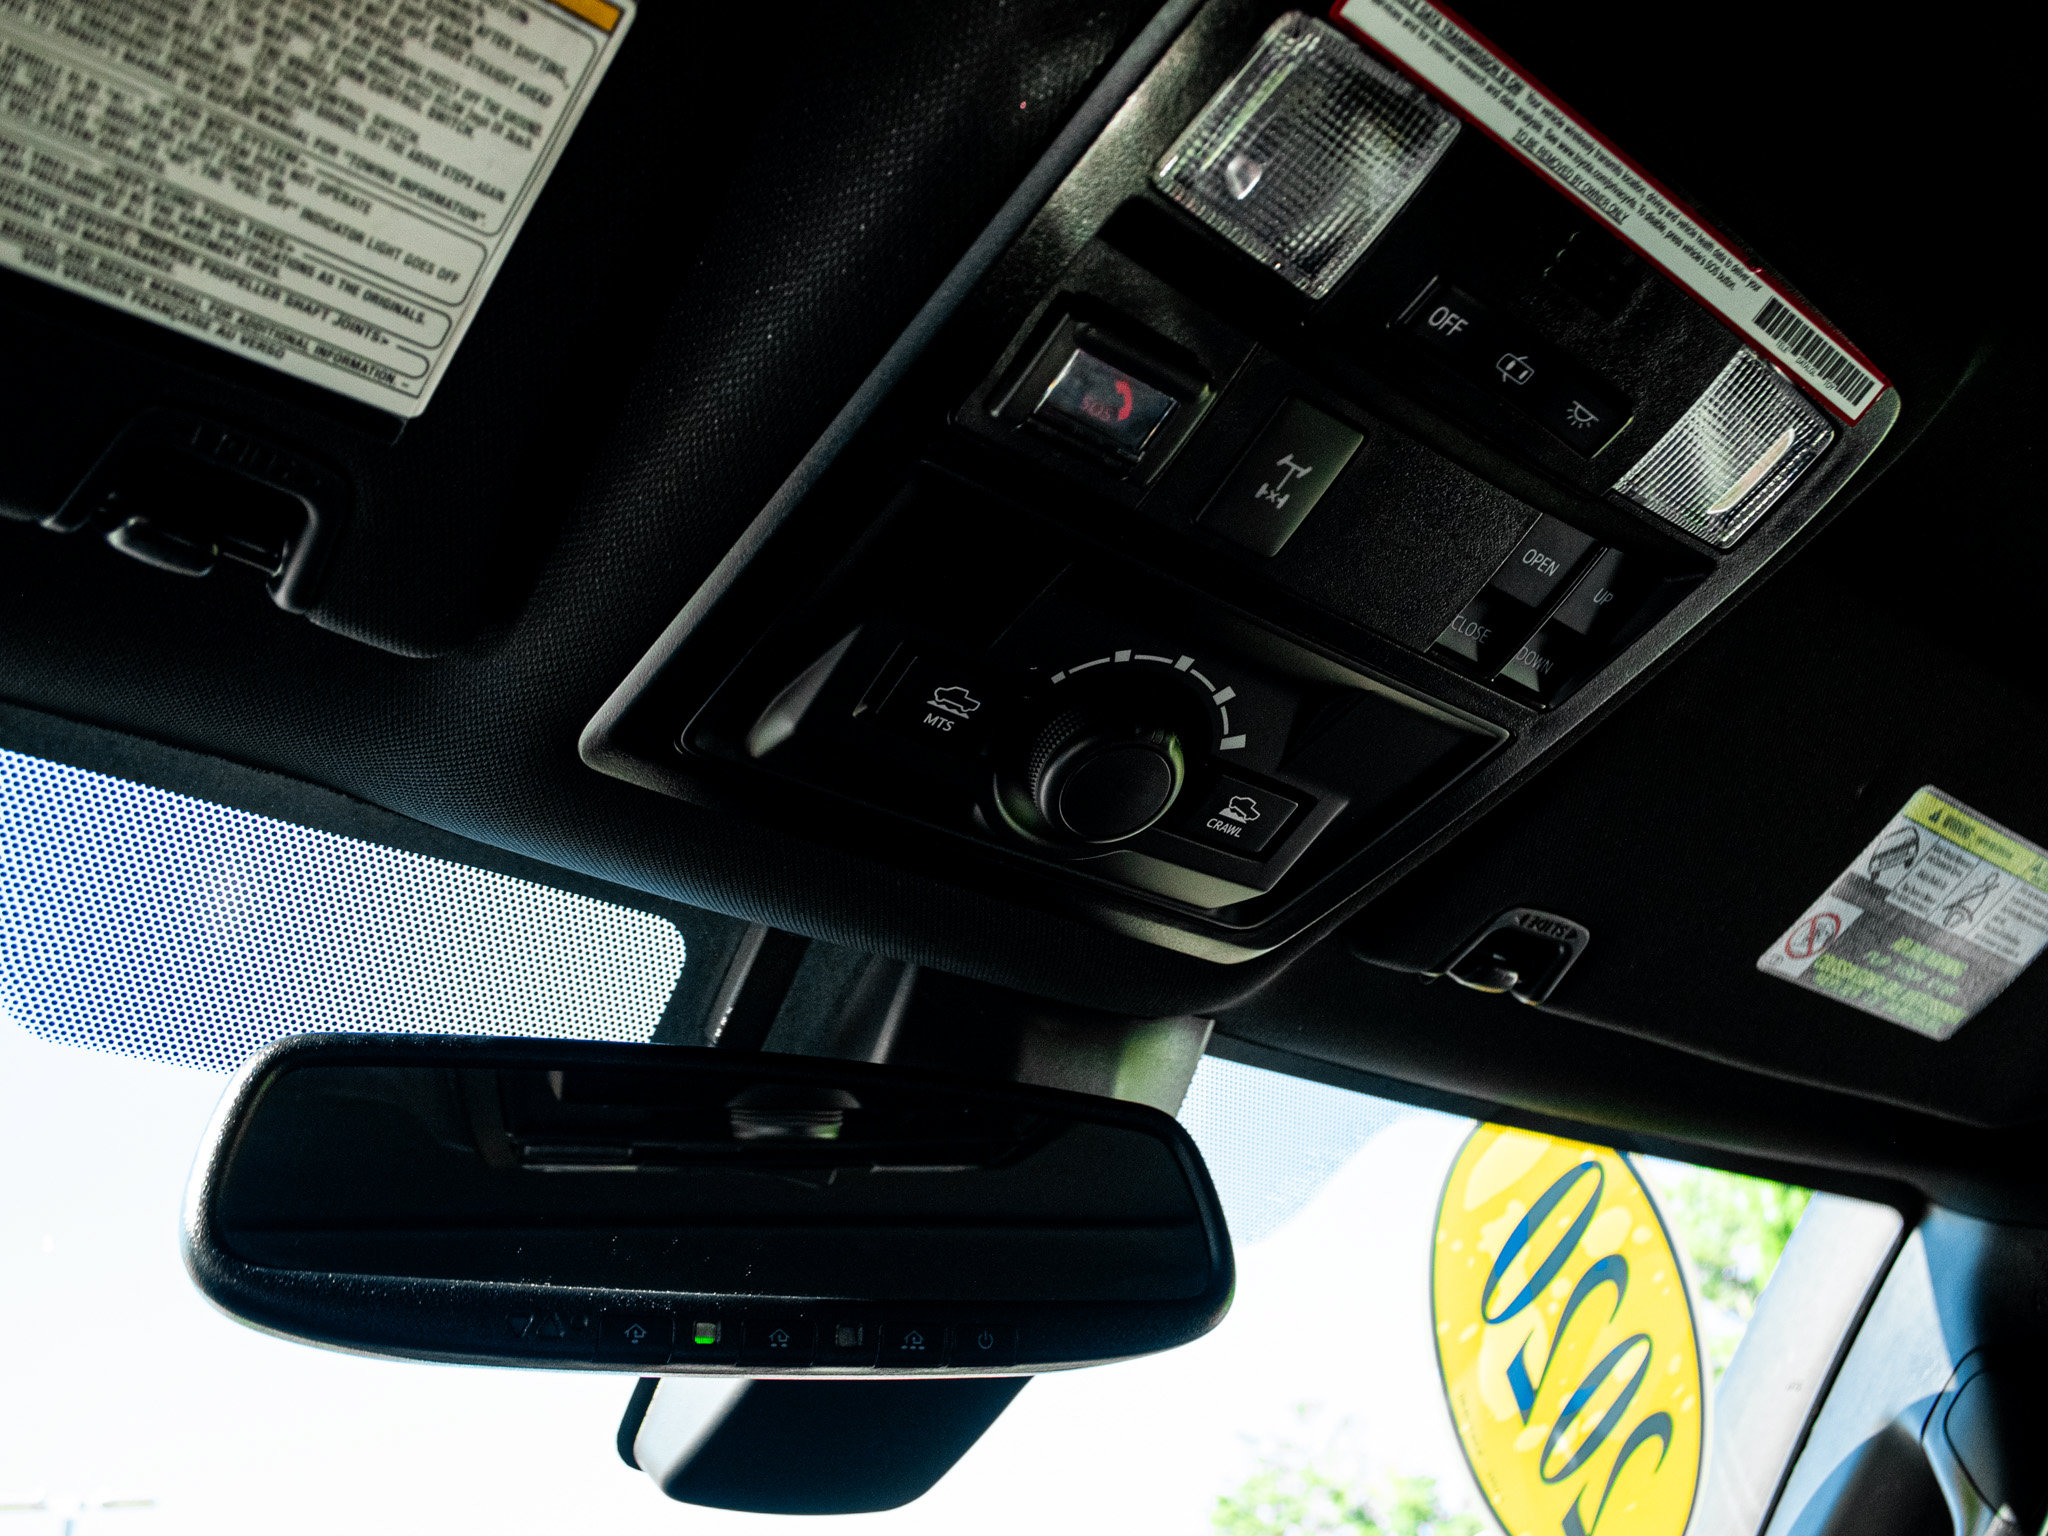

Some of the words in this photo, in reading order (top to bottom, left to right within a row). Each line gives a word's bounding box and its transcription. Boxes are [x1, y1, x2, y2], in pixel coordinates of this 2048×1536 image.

[1536, 145, 1575, 182] REMOVED
[1581, 181, 1611, 211] OWNER
[1606, 201, 1630, 225] ONLY
[366, 238, 402, 259] LIGHT
[402, 254, 435, 275] GOES
[1428, 305, 1469, 338] OFF
[1522, 548, 1561, 577] OPEN
[1593, 587, 1614, 606] UP
[1450, 614, 1493, 644] CLOSE
[1516, 646, 1555, 675] DOWN
[923, 712, 955, 733] MTS
[1205, 817, 1242, 839] CRAWL
